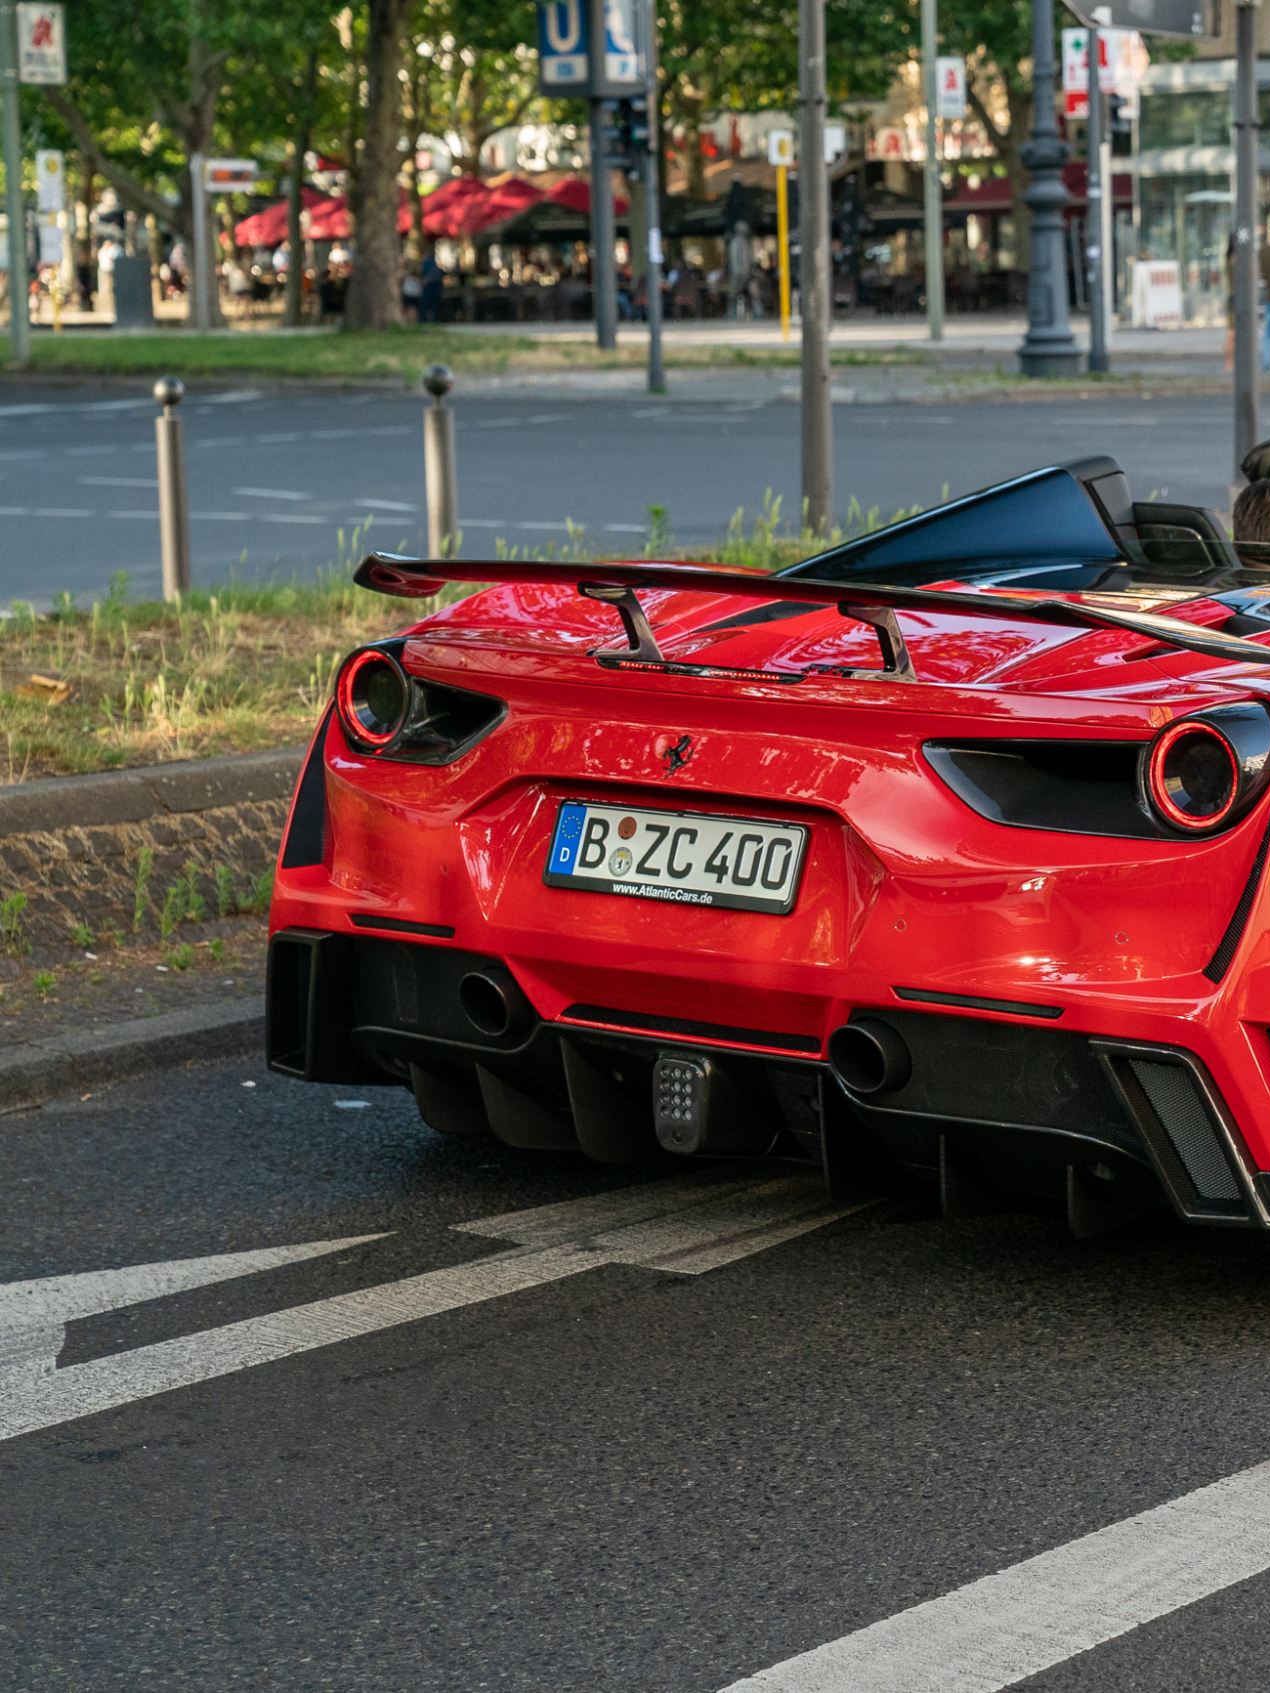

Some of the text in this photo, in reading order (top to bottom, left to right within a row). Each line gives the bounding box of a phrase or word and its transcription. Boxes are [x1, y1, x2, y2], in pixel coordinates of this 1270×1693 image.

[546, 0, 580, 53] U
[559, 847, 571, 863] D
[578, 817, 610, 869] B
[635, 823, 699, 879] ZC
[704, 832, 793, 890] 400
[612, 883, 713, 904] www.AtlanticCars.de
